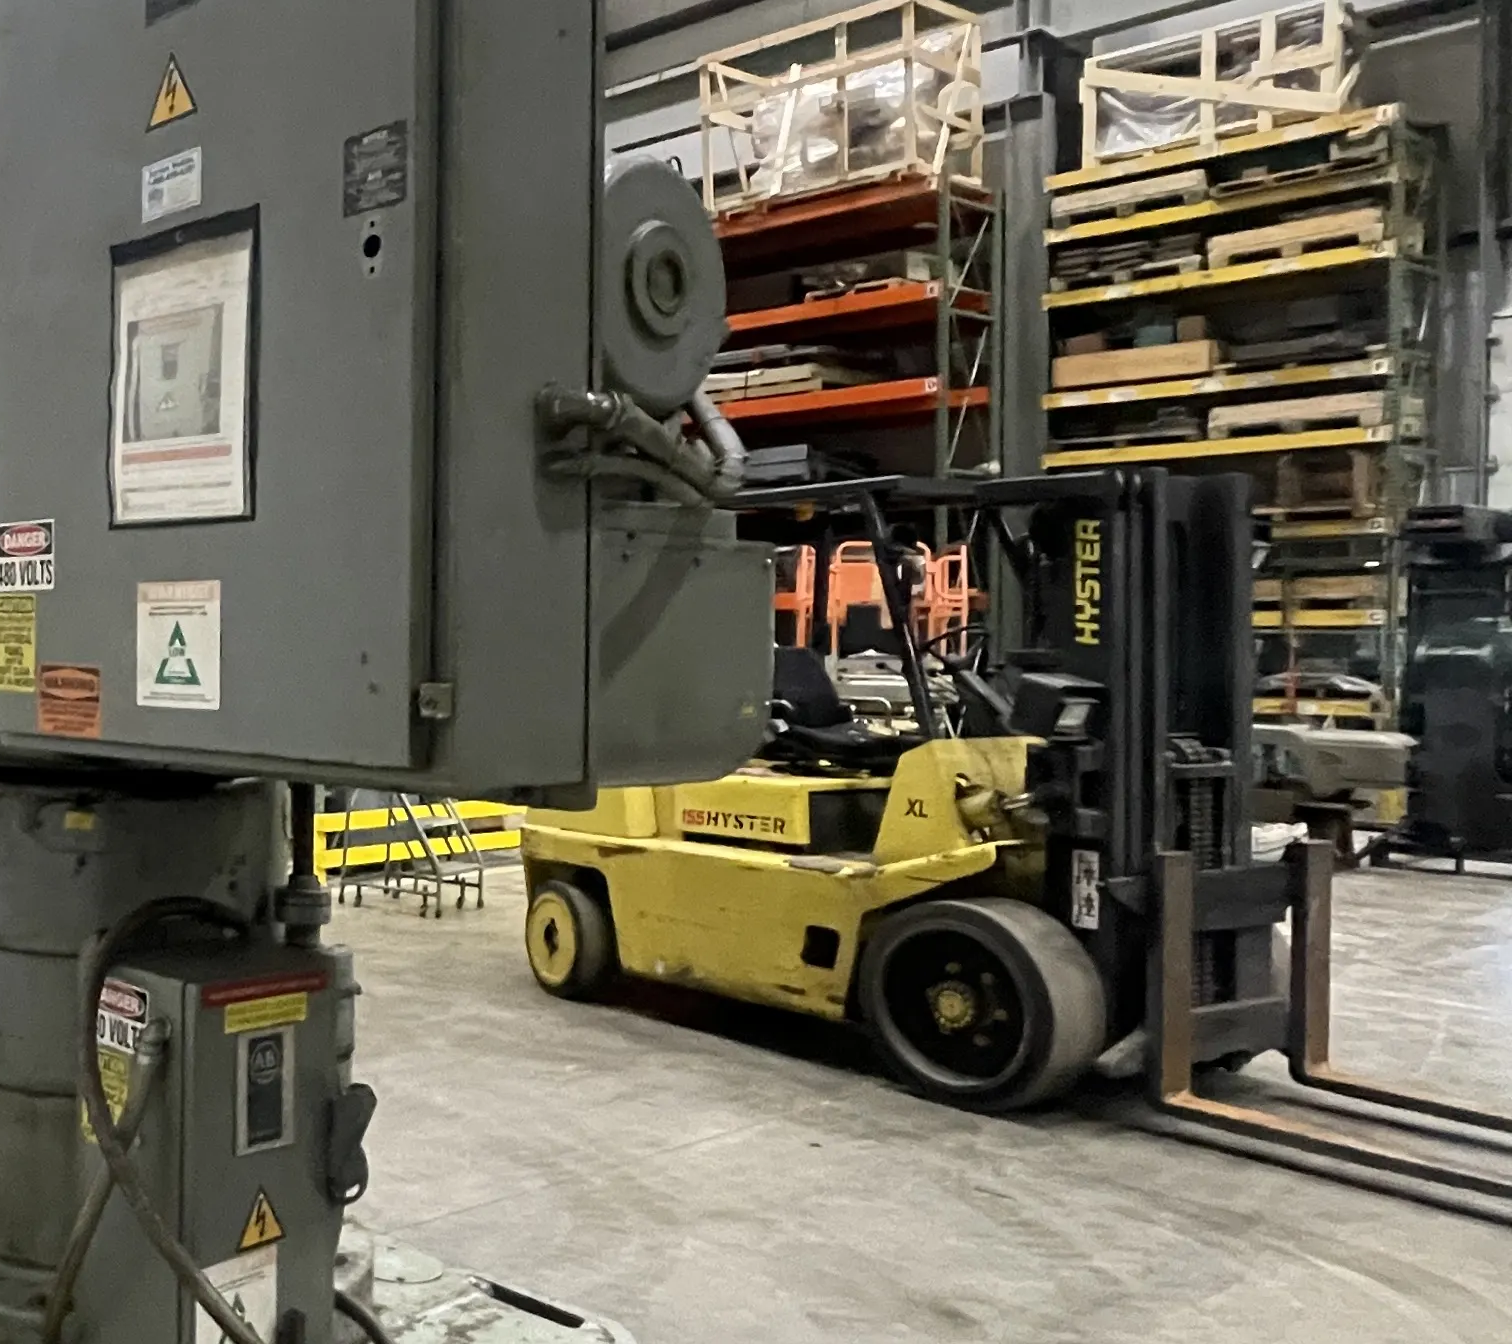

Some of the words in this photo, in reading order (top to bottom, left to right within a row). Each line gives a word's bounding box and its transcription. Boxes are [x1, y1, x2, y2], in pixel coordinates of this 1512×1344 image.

[4, 531, 45, 549] DANGER
[19, 559, 52, 585] VOLTS
[1075, 519, 1101, 645] HYSTER
[904, 798, 929, 818] XL
[706, 811, 786, 835] HYSTER
[109, 1017, 139, 1049] VOLT
